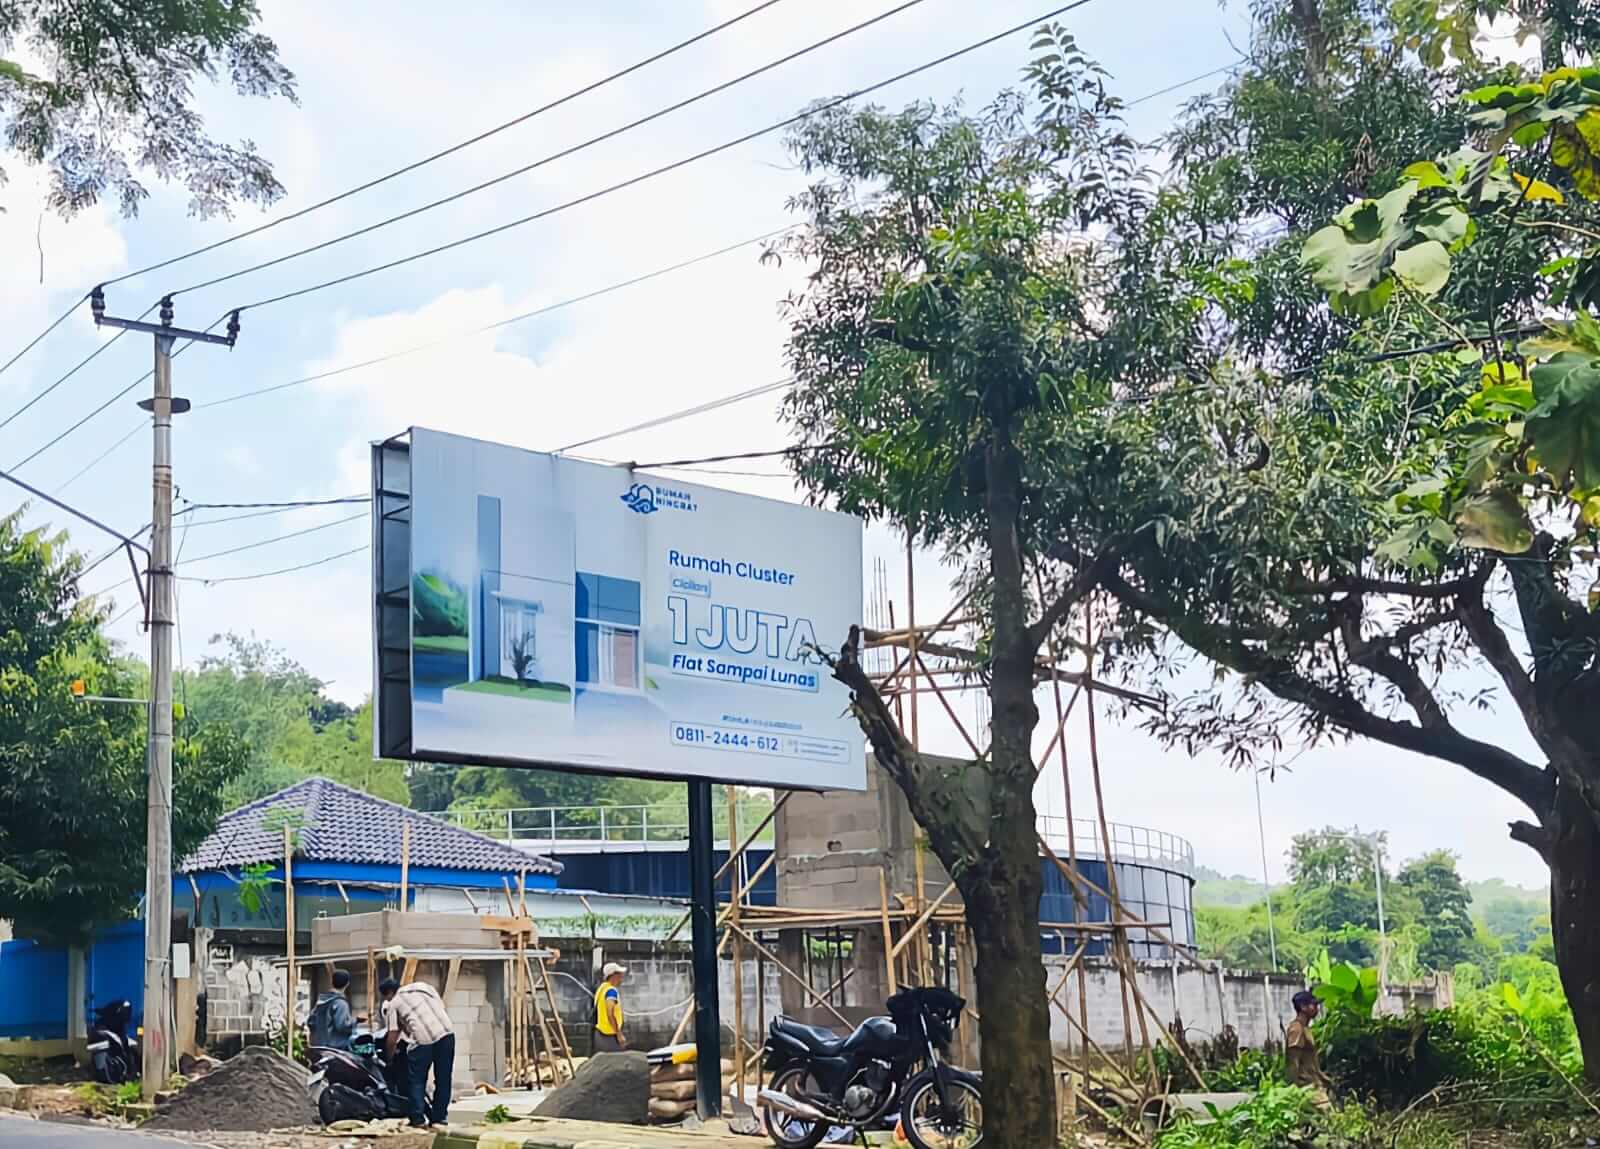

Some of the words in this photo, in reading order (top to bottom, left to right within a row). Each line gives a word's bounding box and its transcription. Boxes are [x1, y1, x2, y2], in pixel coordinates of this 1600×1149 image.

[669, 550, 732, 575] Rumah
[735, 562, 795, 585] Cluster
[672, 578, 708, 593] Cicilan
[672, 654, 704, 671] Flat
[706, 659, 768, 684] Sampai
[771, 668, 816, 688] Lunas
[676, 727, 778, 751] 0811-2444-612
